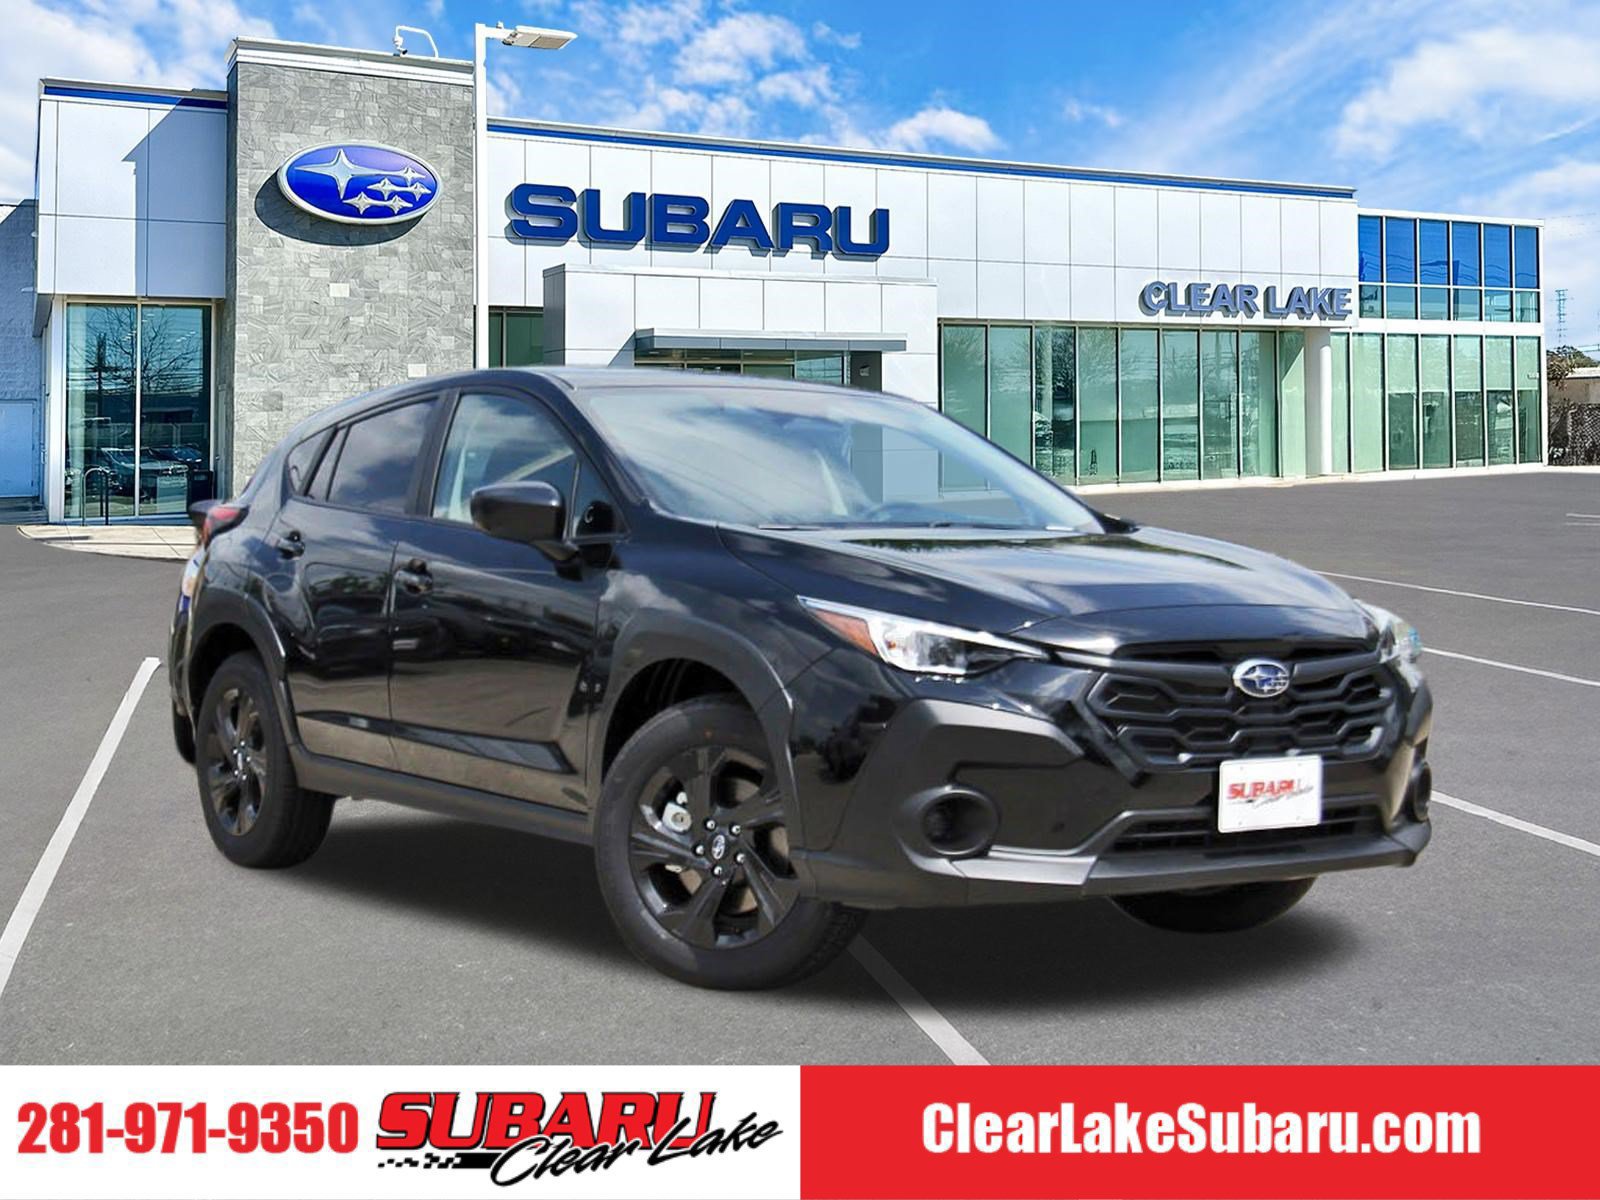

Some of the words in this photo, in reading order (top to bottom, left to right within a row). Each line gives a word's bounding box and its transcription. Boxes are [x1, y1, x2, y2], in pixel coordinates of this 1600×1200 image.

[505, 183, 889, 260] SUBARU
[1139, 281, 1260, 318] CLEAR
[1264, 285, 1352, 320] LAKE
